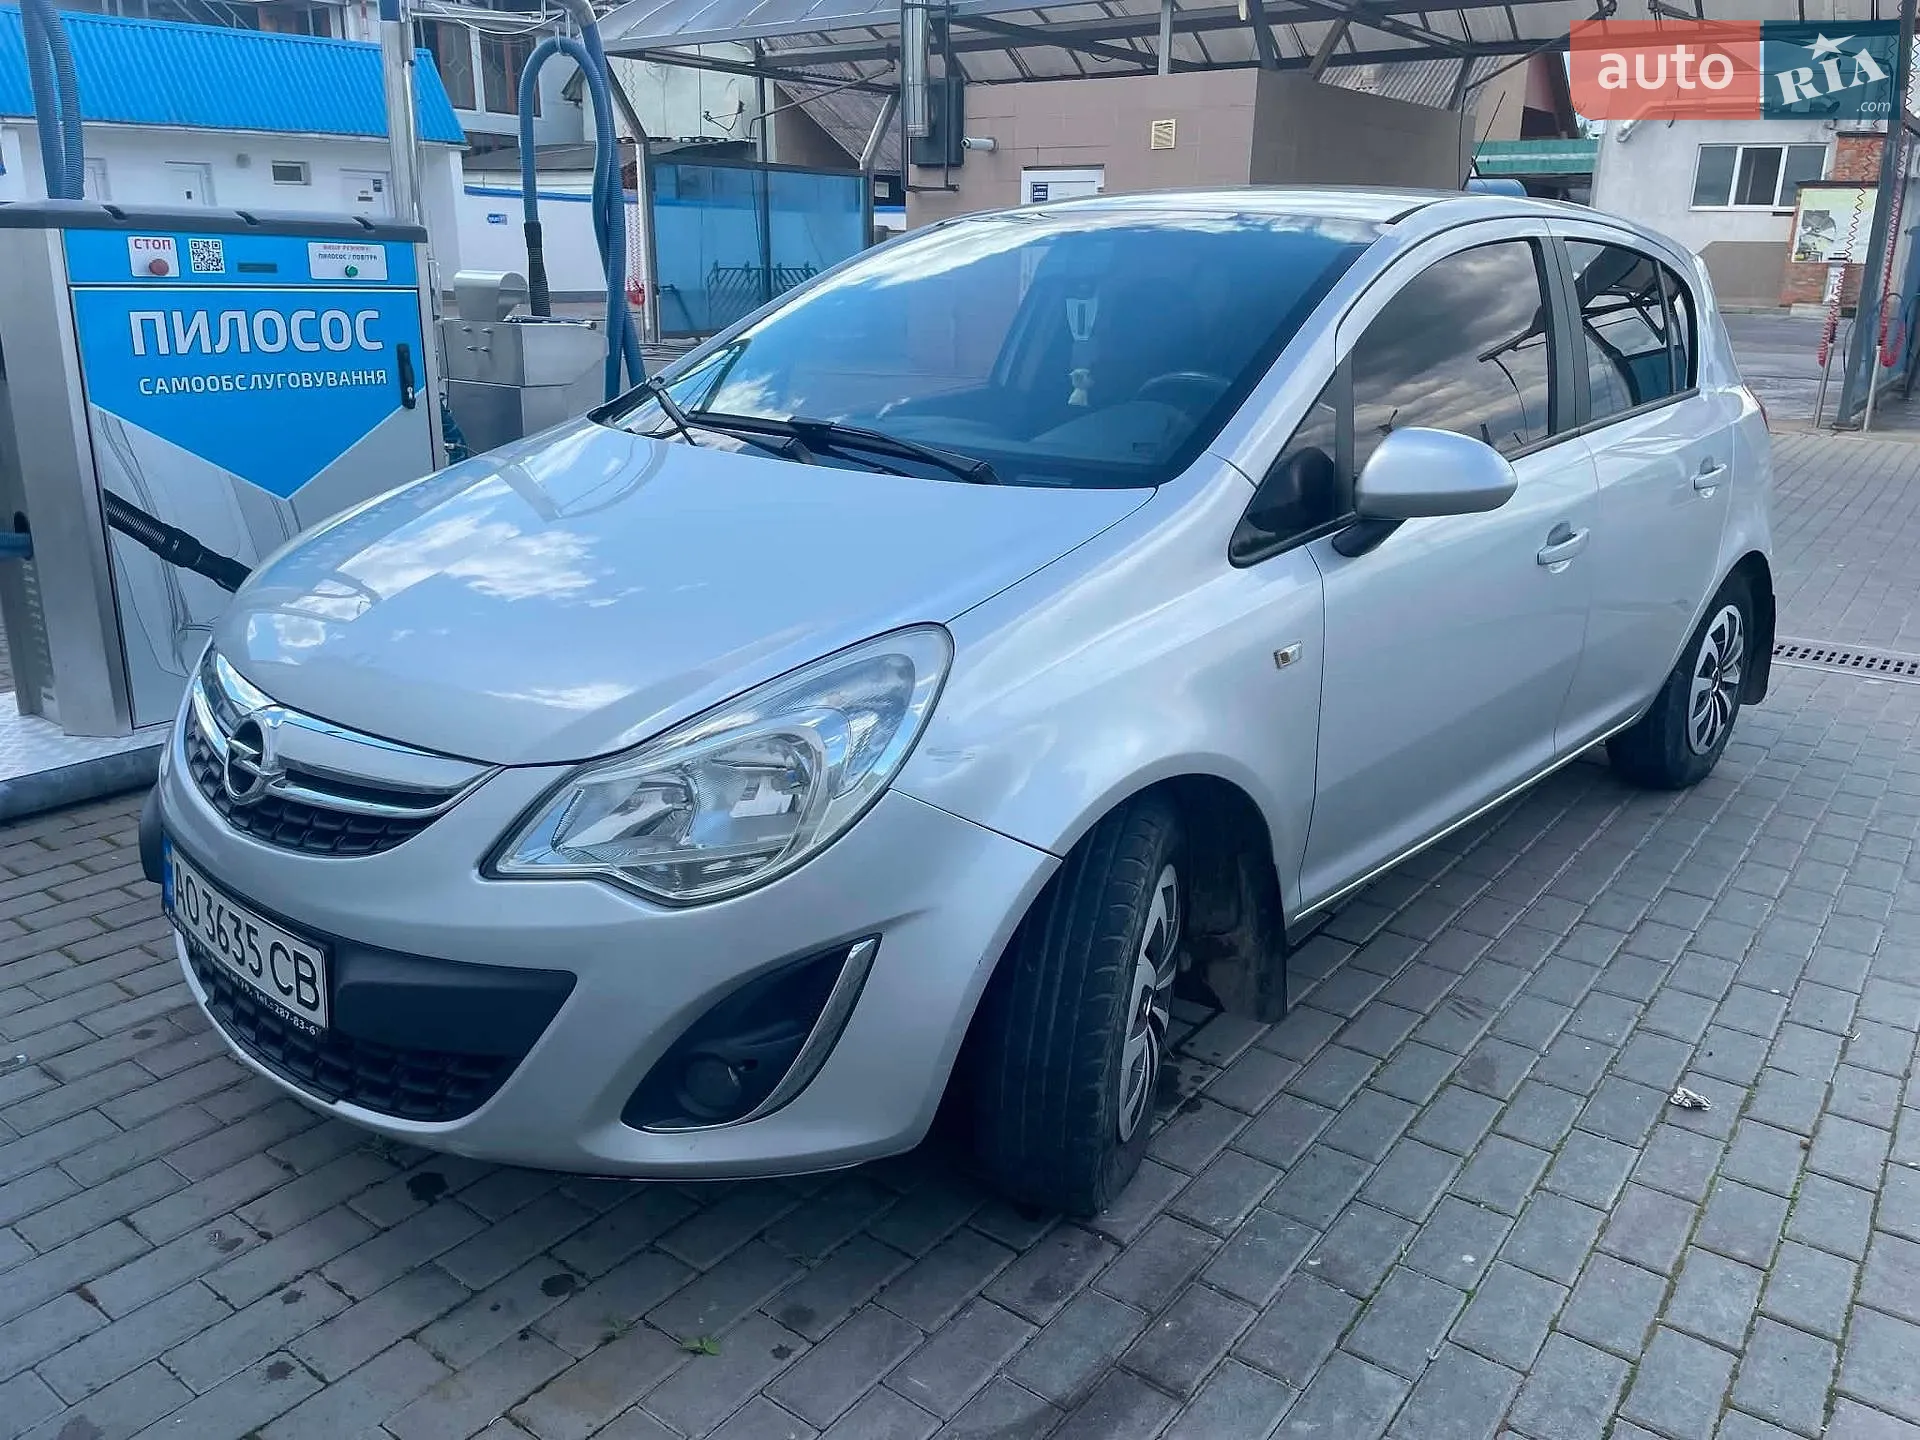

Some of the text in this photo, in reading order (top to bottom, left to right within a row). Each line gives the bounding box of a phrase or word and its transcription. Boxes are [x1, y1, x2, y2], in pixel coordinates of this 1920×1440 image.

[134, 238, 172, 250] СТОП
[128, 308, 384, 356] ПИЛОСОС
[139, 369, 387, 395] САМООБСЛУГОВУВАННЯ
